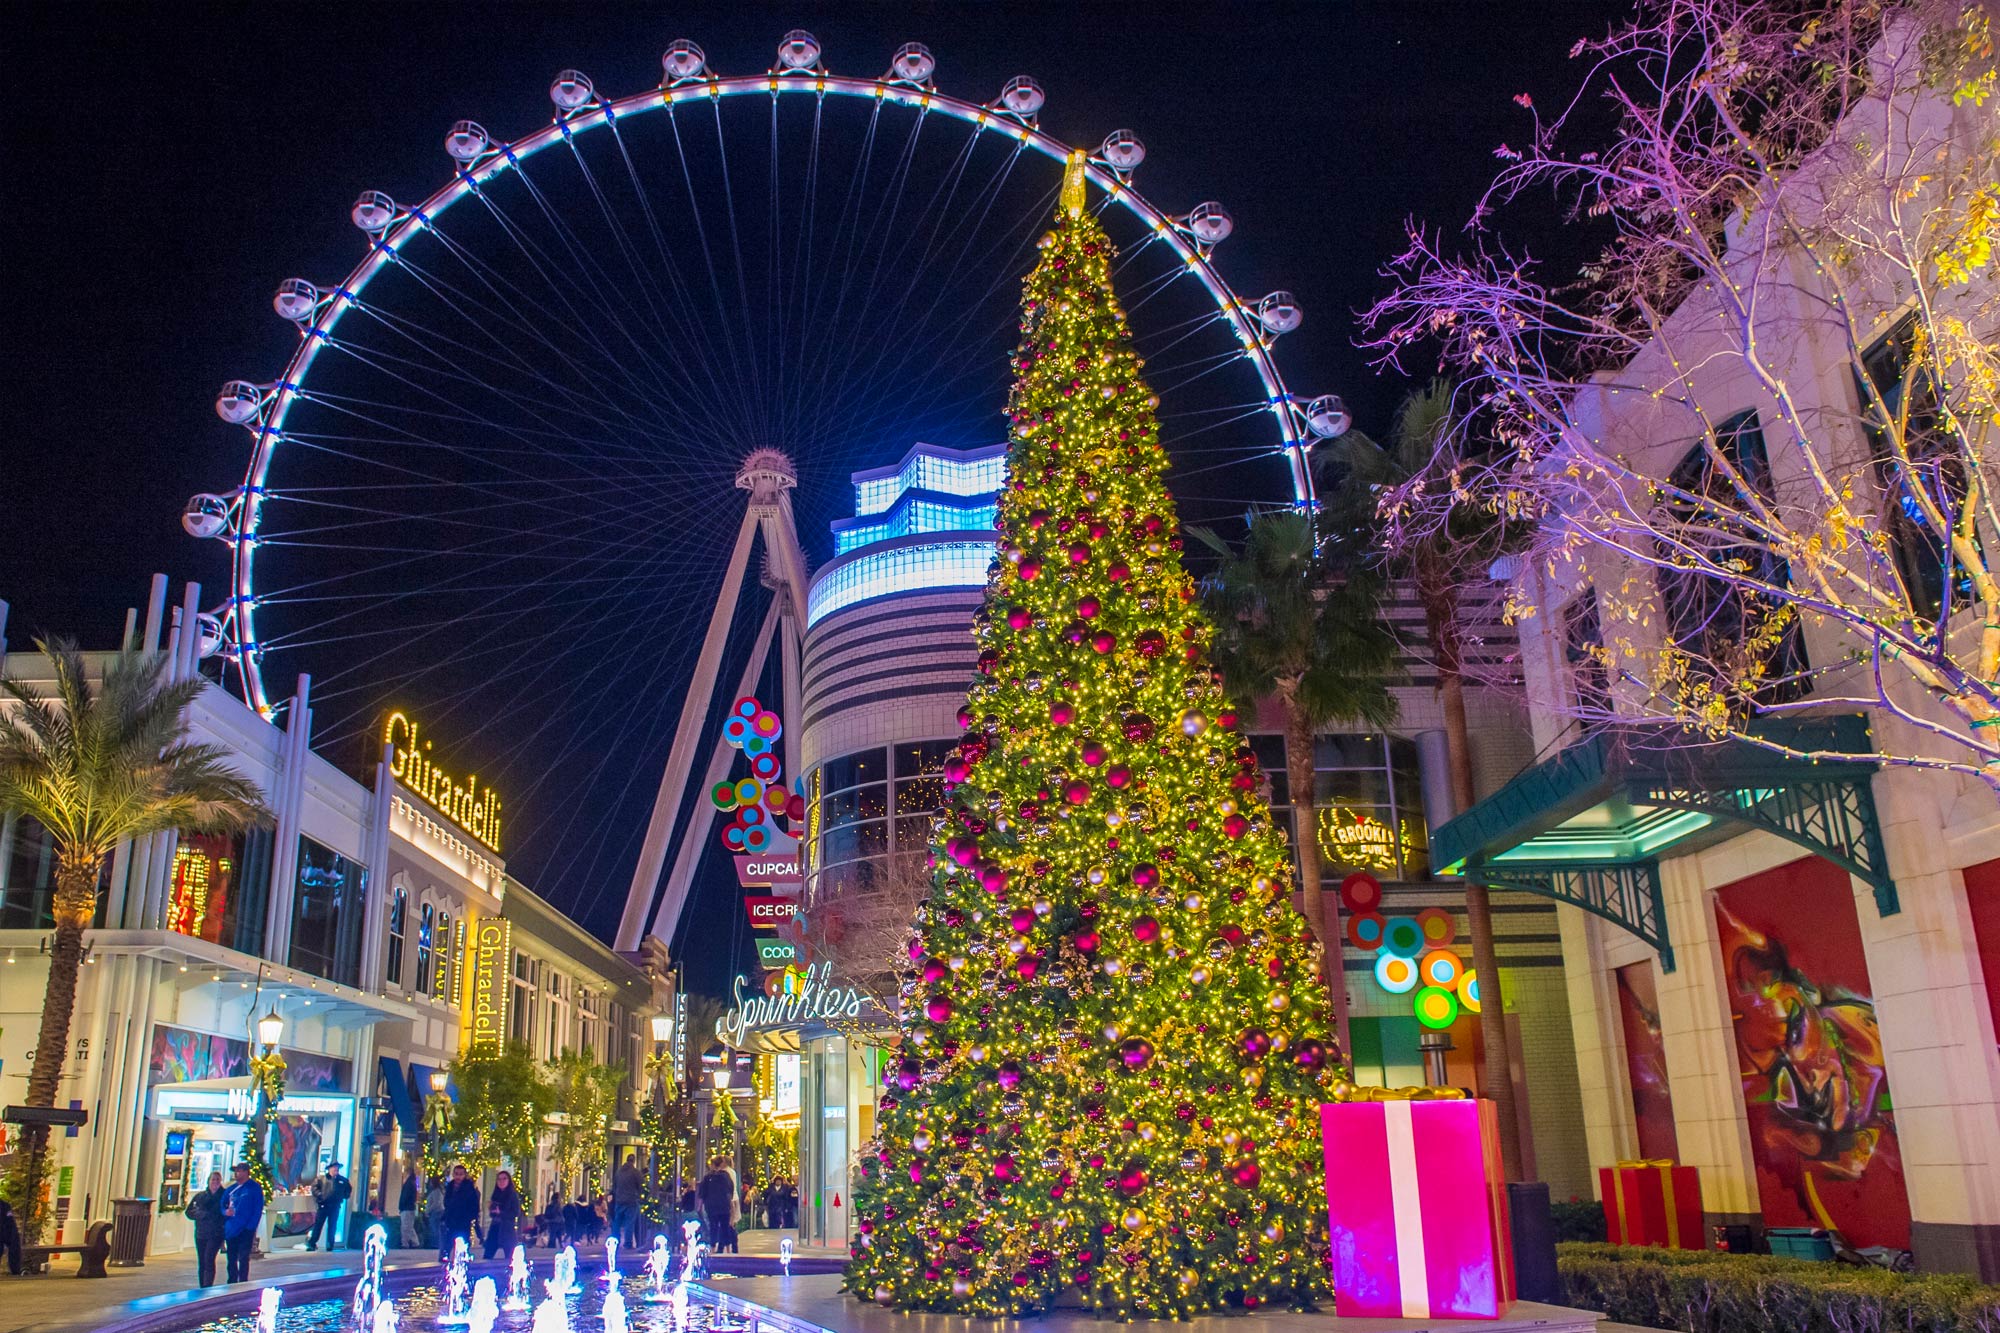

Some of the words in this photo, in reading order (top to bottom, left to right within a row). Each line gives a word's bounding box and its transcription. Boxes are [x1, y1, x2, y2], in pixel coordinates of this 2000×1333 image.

[385, 711, 502, 852] Ghirardelli
[753, 904, 774, 916] ICE
[726, 960, 872, 1047] Sprinkles
